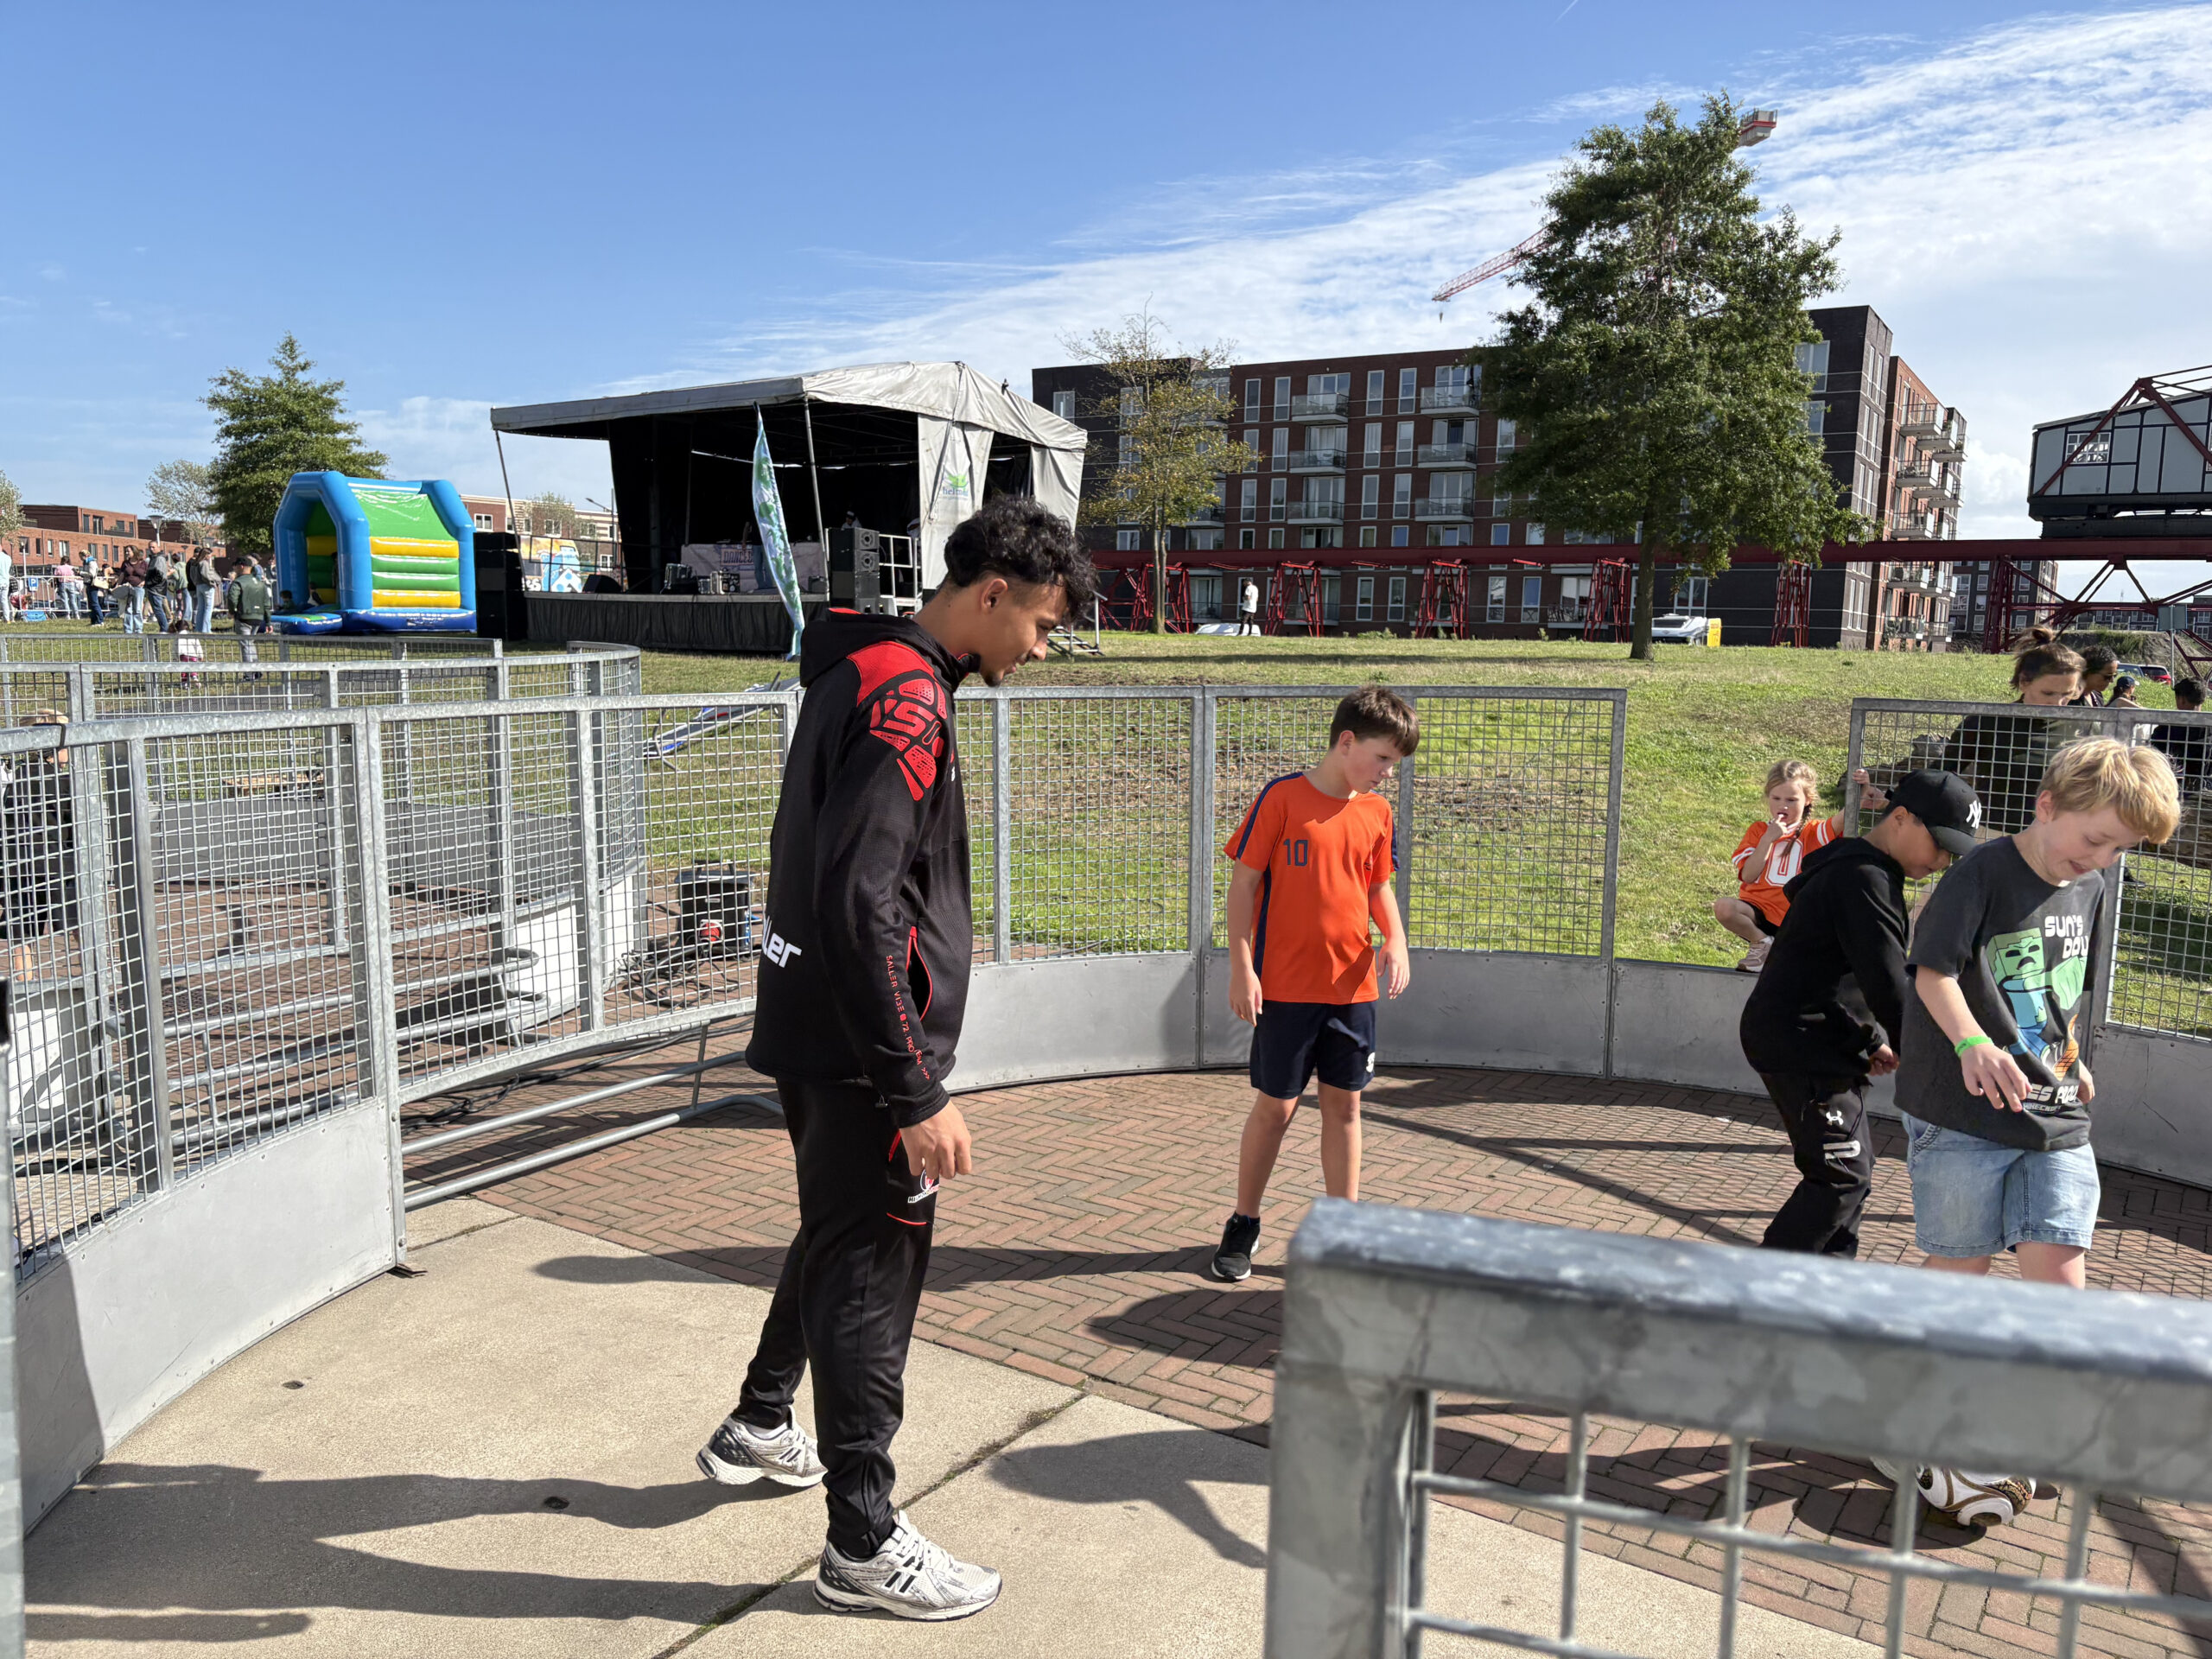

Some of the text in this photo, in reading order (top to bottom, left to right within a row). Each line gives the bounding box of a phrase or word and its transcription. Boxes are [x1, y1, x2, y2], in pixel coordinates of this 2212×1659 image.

[1283, 838, 1308, 867] 10
[1754, 838, 1803, 887] 0
[2044, 914, 2083, 938] SUN'S
[886, 955, 898, 988] SALLER
[893, 990, 905, 1013] VIBE
[902, 1021, 910, 1033] 72
